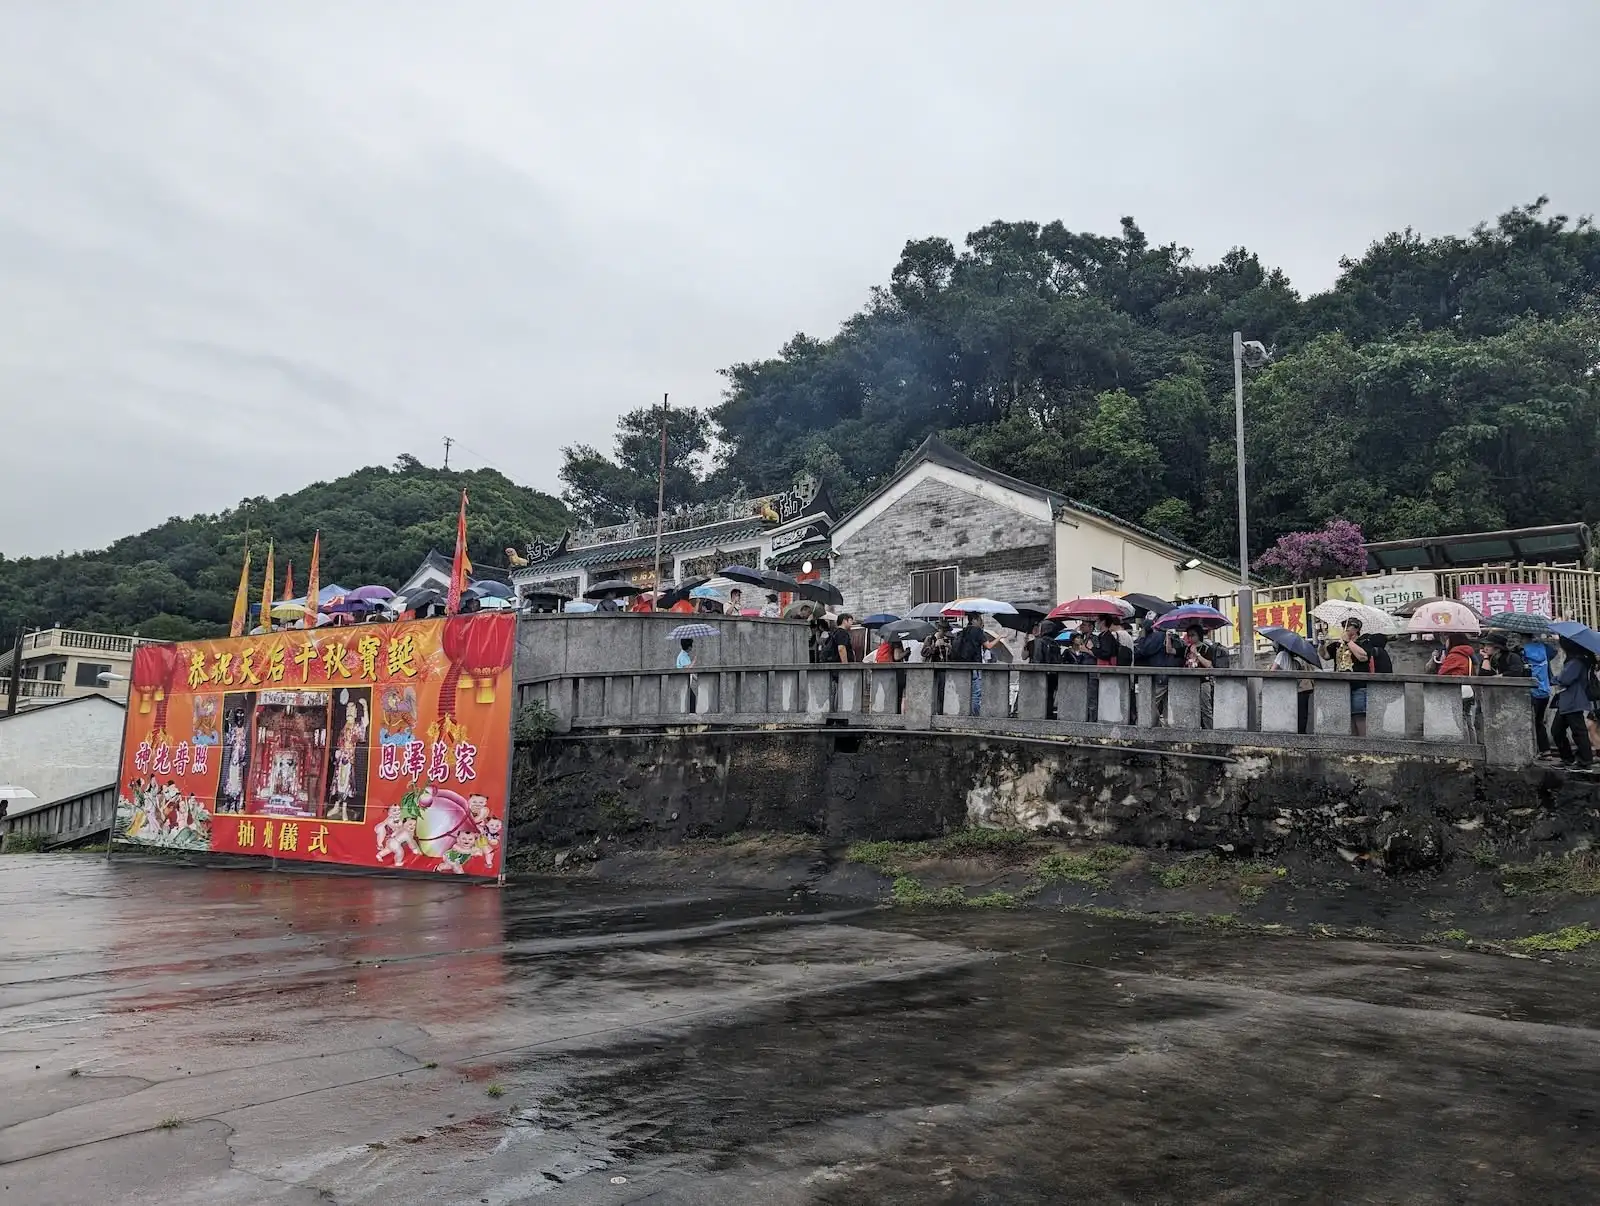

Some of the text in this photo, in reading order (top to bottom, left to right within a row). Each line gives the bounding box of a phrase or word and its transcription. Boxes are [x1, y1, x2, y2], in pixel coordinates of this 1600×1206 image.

[1373, 591, 1424, 605] 自己垃圾
[1461, 588, 1552, 619] 觀音寶誕
[1236, 602, 1304, 632] 澤萬家
[187, 635, 418, 690] 恭祝天后千秋寶誕
[135, 740, 208, 776] 神光普照
[378, 740, 478, 783] 恩澤萬家
